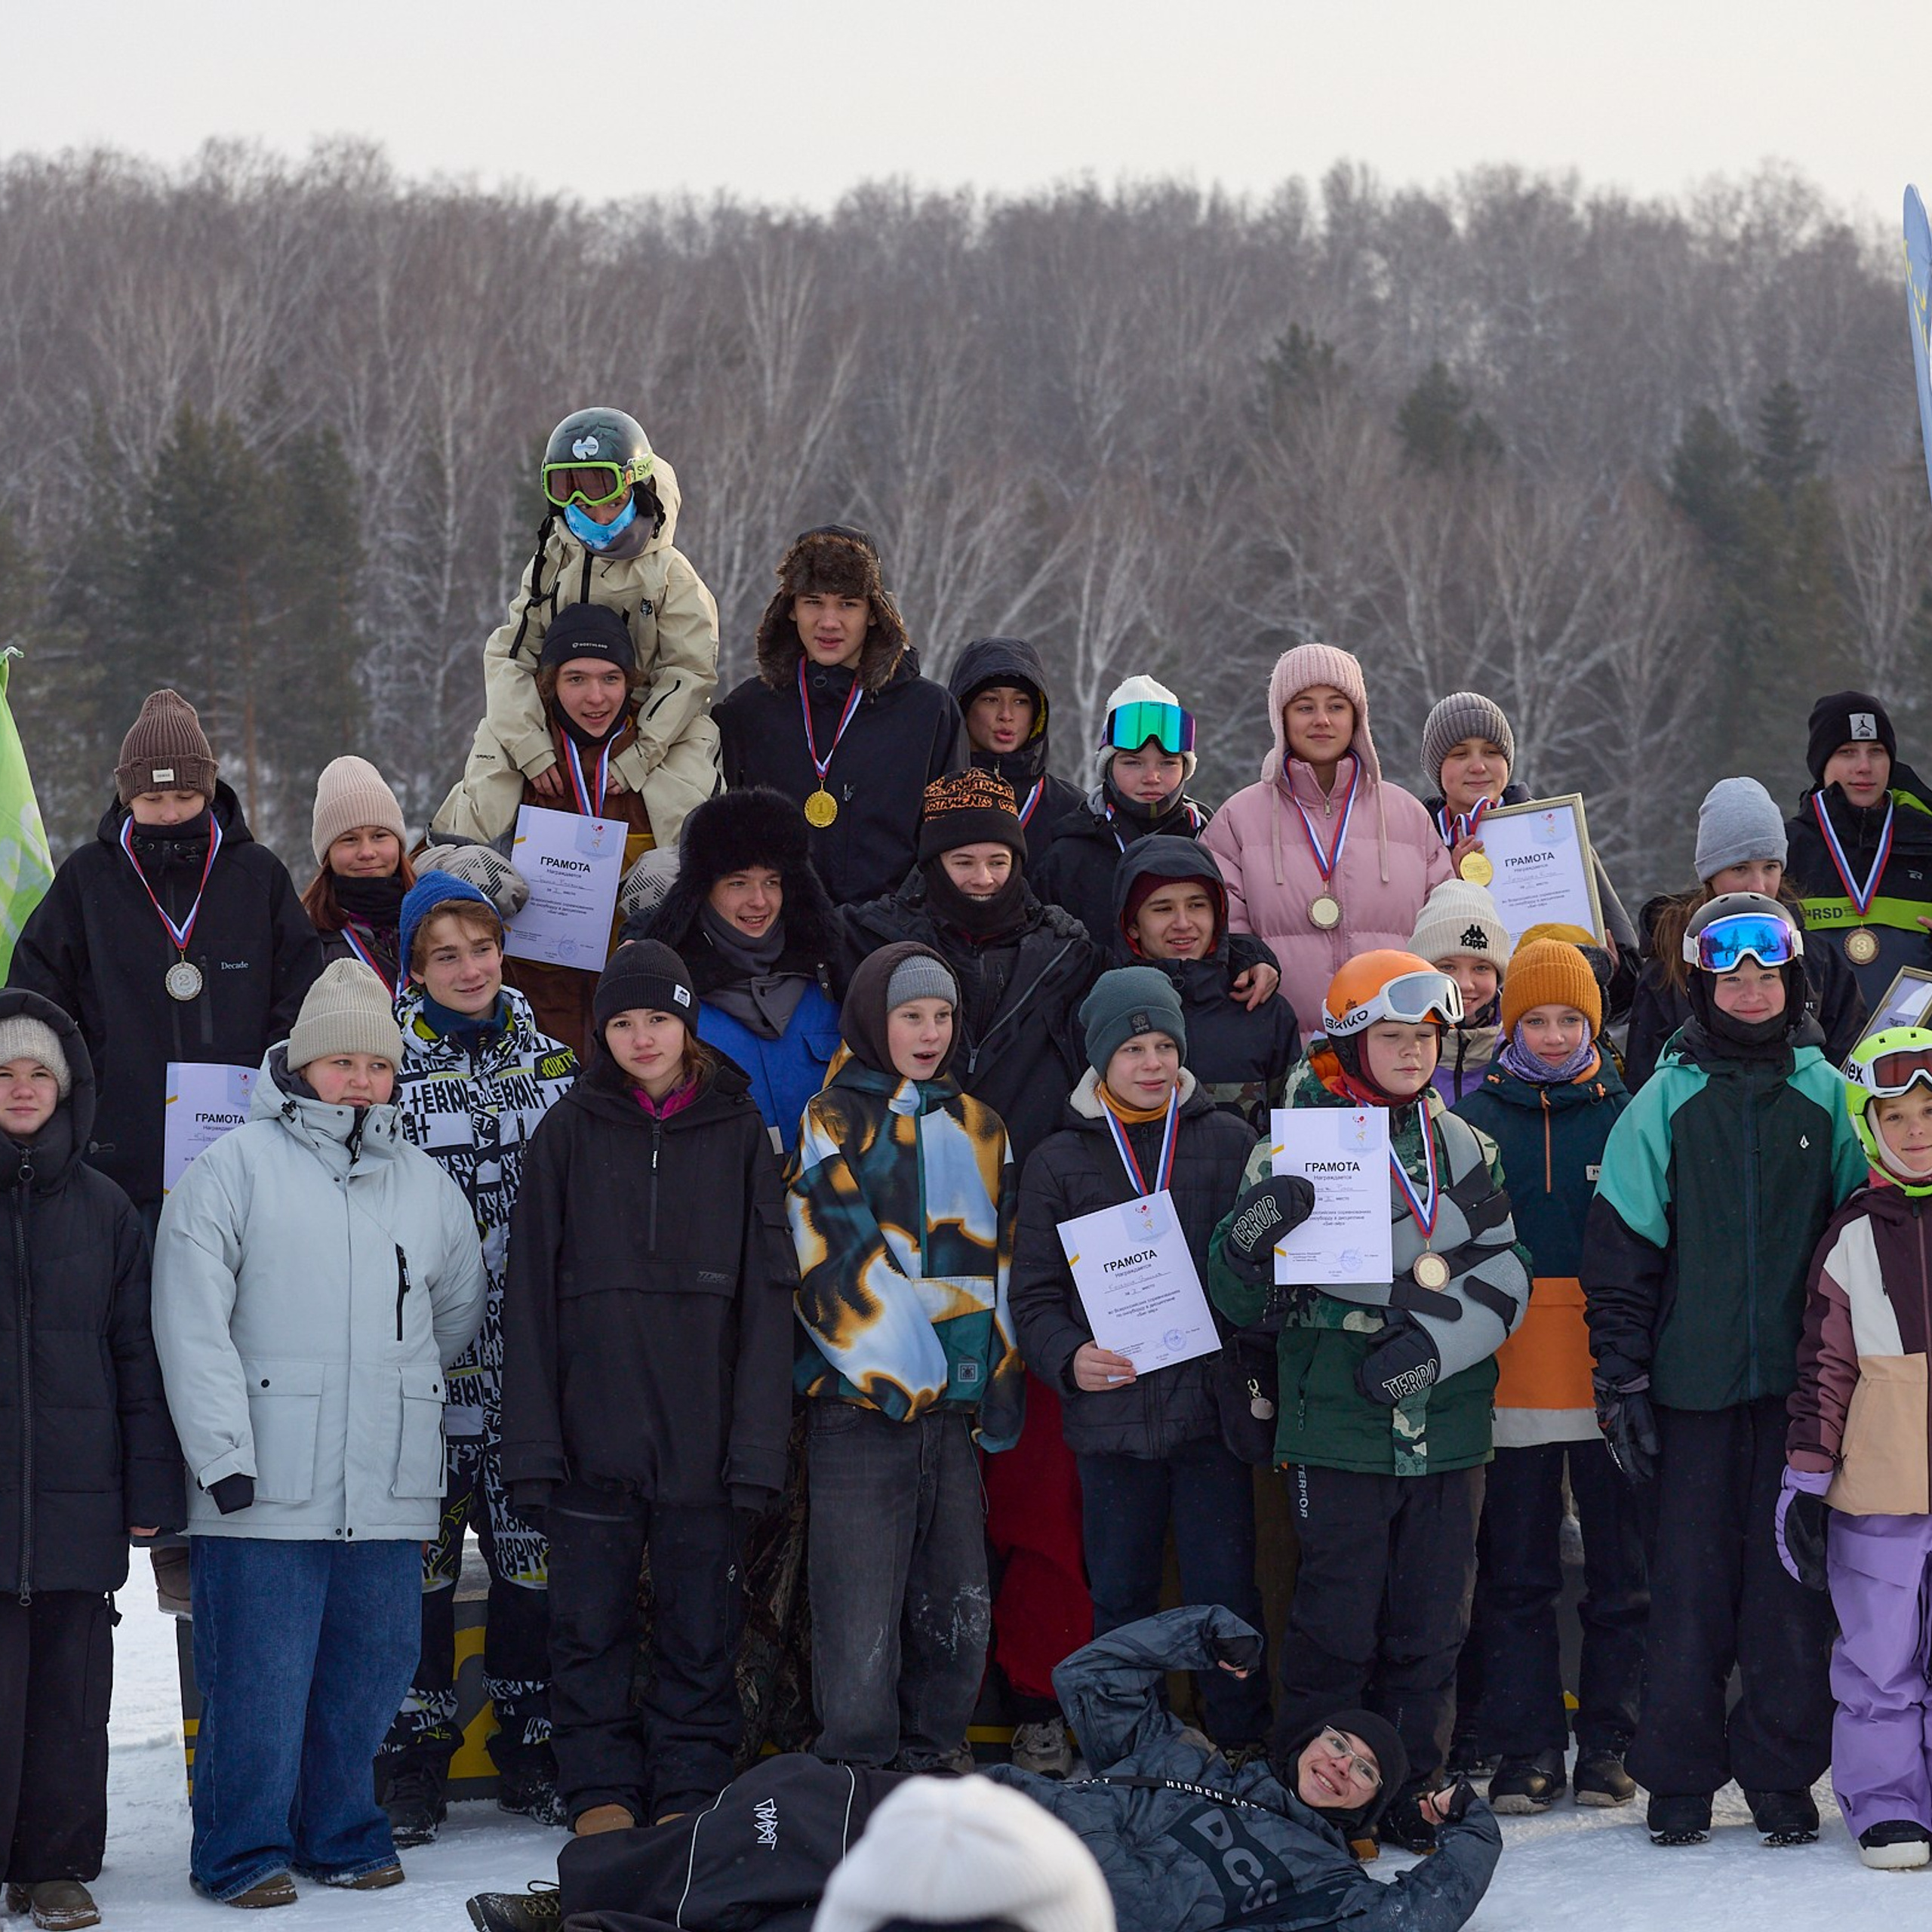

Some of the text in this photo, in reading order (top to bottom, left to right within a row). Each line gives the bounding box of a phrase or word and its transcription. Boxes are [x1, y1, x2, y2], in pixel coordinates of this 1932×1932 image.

[540, 856, 591, 872] ГРАМОТА
[1504, 851, 1555, 867] ГРАМОТА
[1461, 937, 1487, 949] Kappa
[220, 961, 249, 971] Decade
[195, 1113, 245, 1124] ГРАМОТА
[1305, 1161, 1361, 1173] ГРАМОТА
[1232, 1195, 1282, 1253] TERROR
[1103, 1249, 1158, 1273] ГРАМОТА
[1382, 1358, 1438, 1399] TERRO
[1166, 1780, 1223, 1801] HIDDEN
